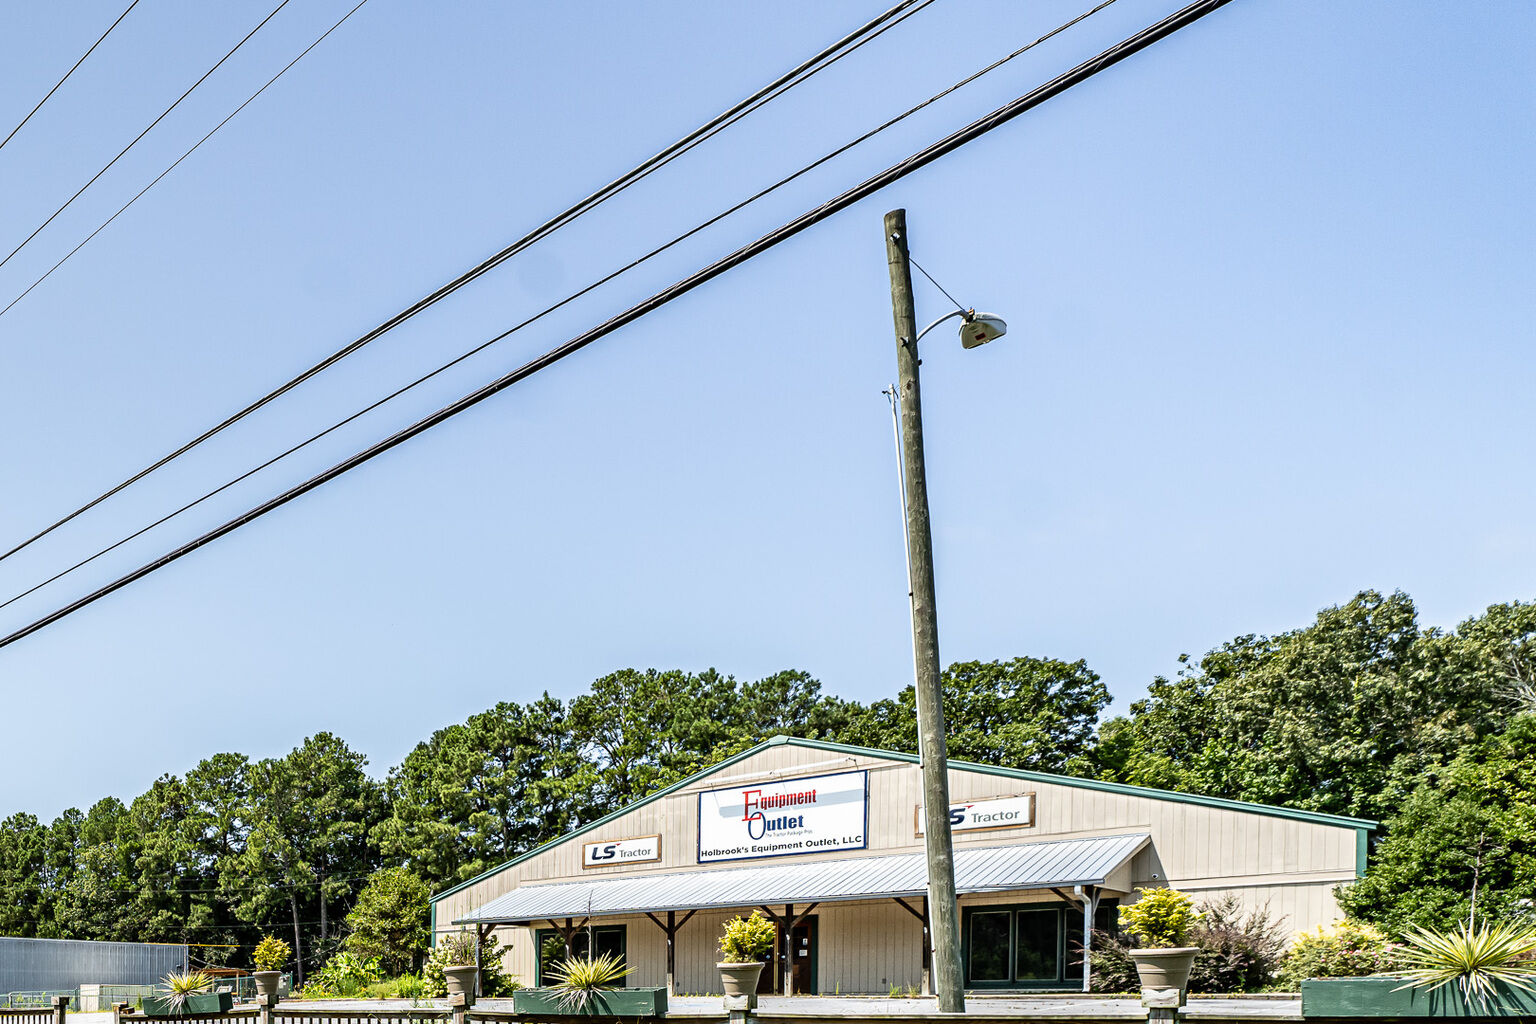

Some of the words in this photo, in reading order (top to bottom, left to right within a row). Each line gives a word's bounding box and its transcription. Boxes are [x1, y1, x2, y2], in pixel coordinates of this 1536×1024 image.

[742, 789, 816, 821] Equipment
[949, 807, 966, 825] S
[971, 811, 1020, 823] Tractor
[748, 811, 804, 840] Outlet
[592, 845, 617, 860] LS
[619, 849, 651, 858] Tractor
[701, 846, 749, 857] Holbrook's
[752, 842, 802, 853] Equipment
[806, 837, 839, 848] Outlet,
[842, 835, 862, 844] LLC
